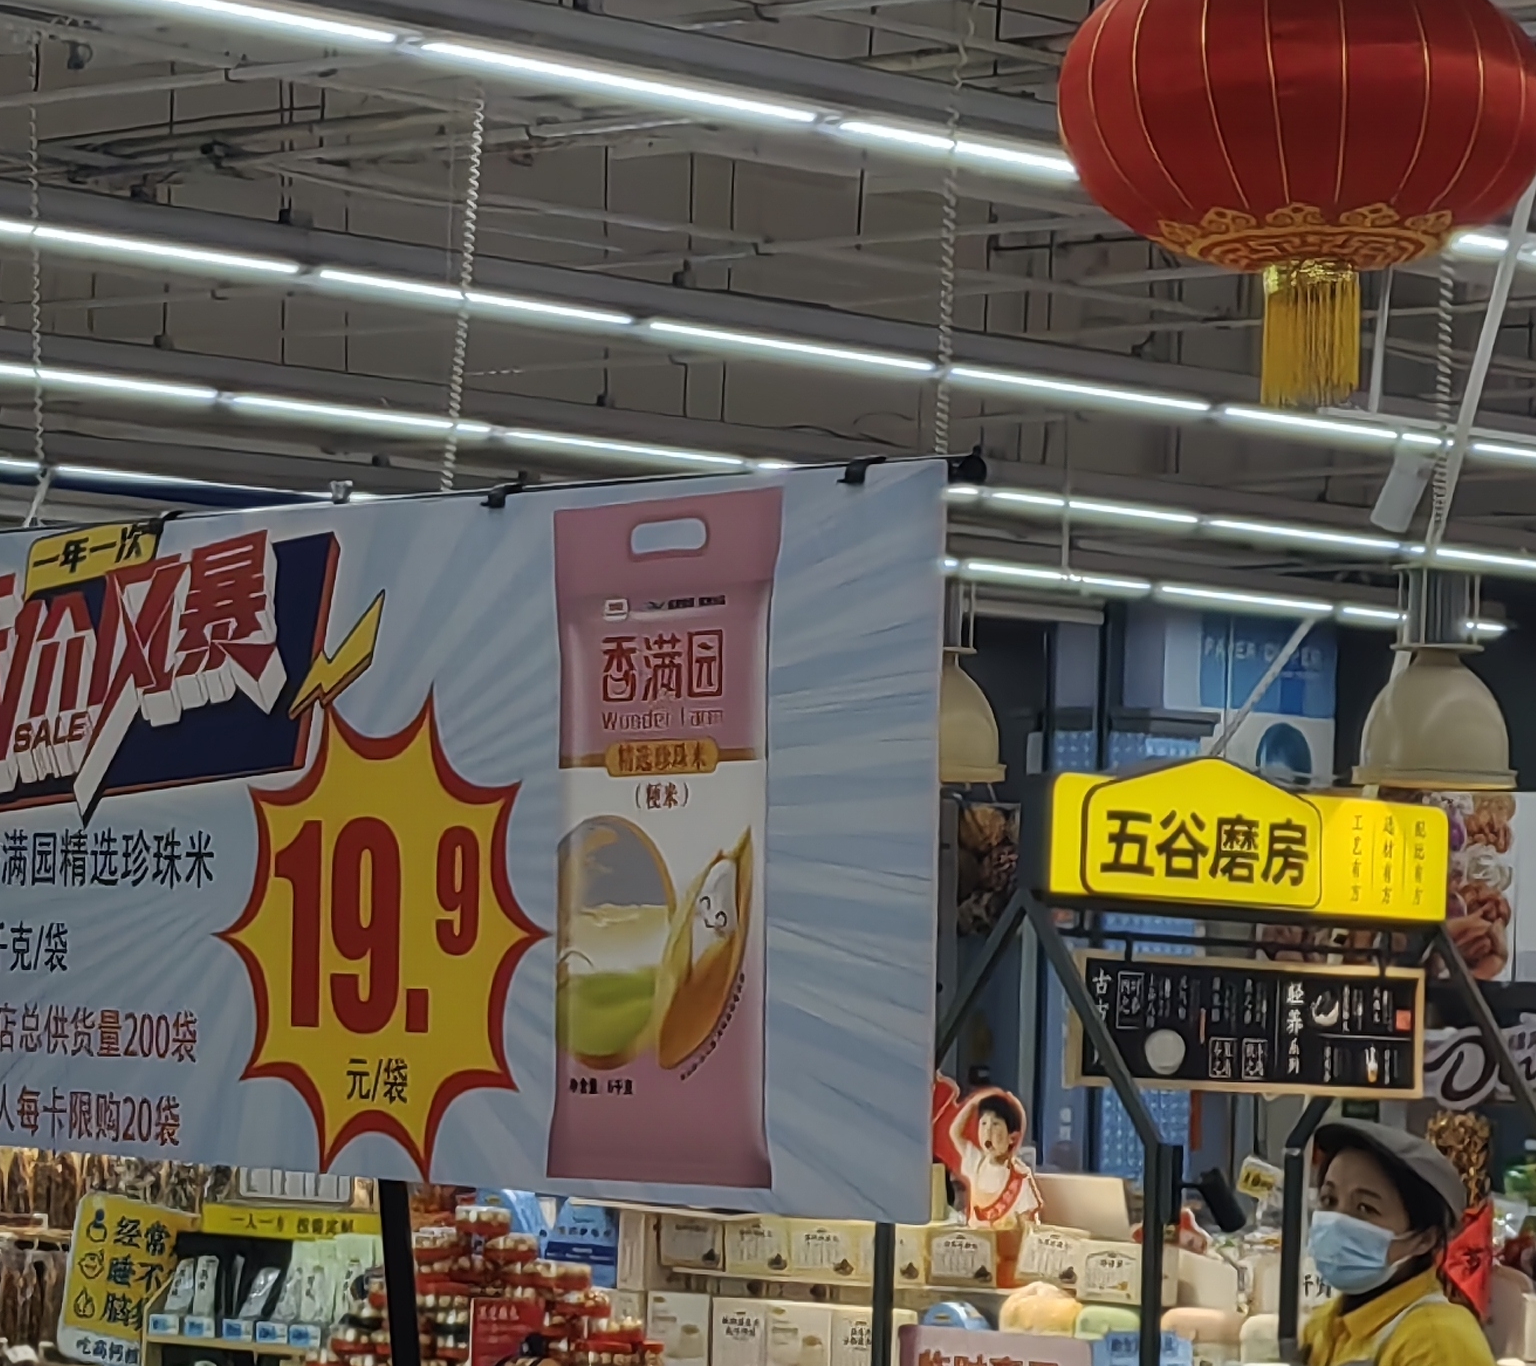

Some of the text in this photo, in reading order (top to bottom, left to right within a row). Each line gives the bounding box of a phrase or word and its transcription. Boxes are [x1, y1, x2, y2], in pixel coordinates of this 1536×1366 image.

[32, 524, 148, 574] 一年一次
[602, 628, 723, 703] 香满园
[13, 712, 88, 754] SALE
[1100, 808, 1310, 888] 五谷磨房
[345, 1057, 409, 1105] 元/袋
